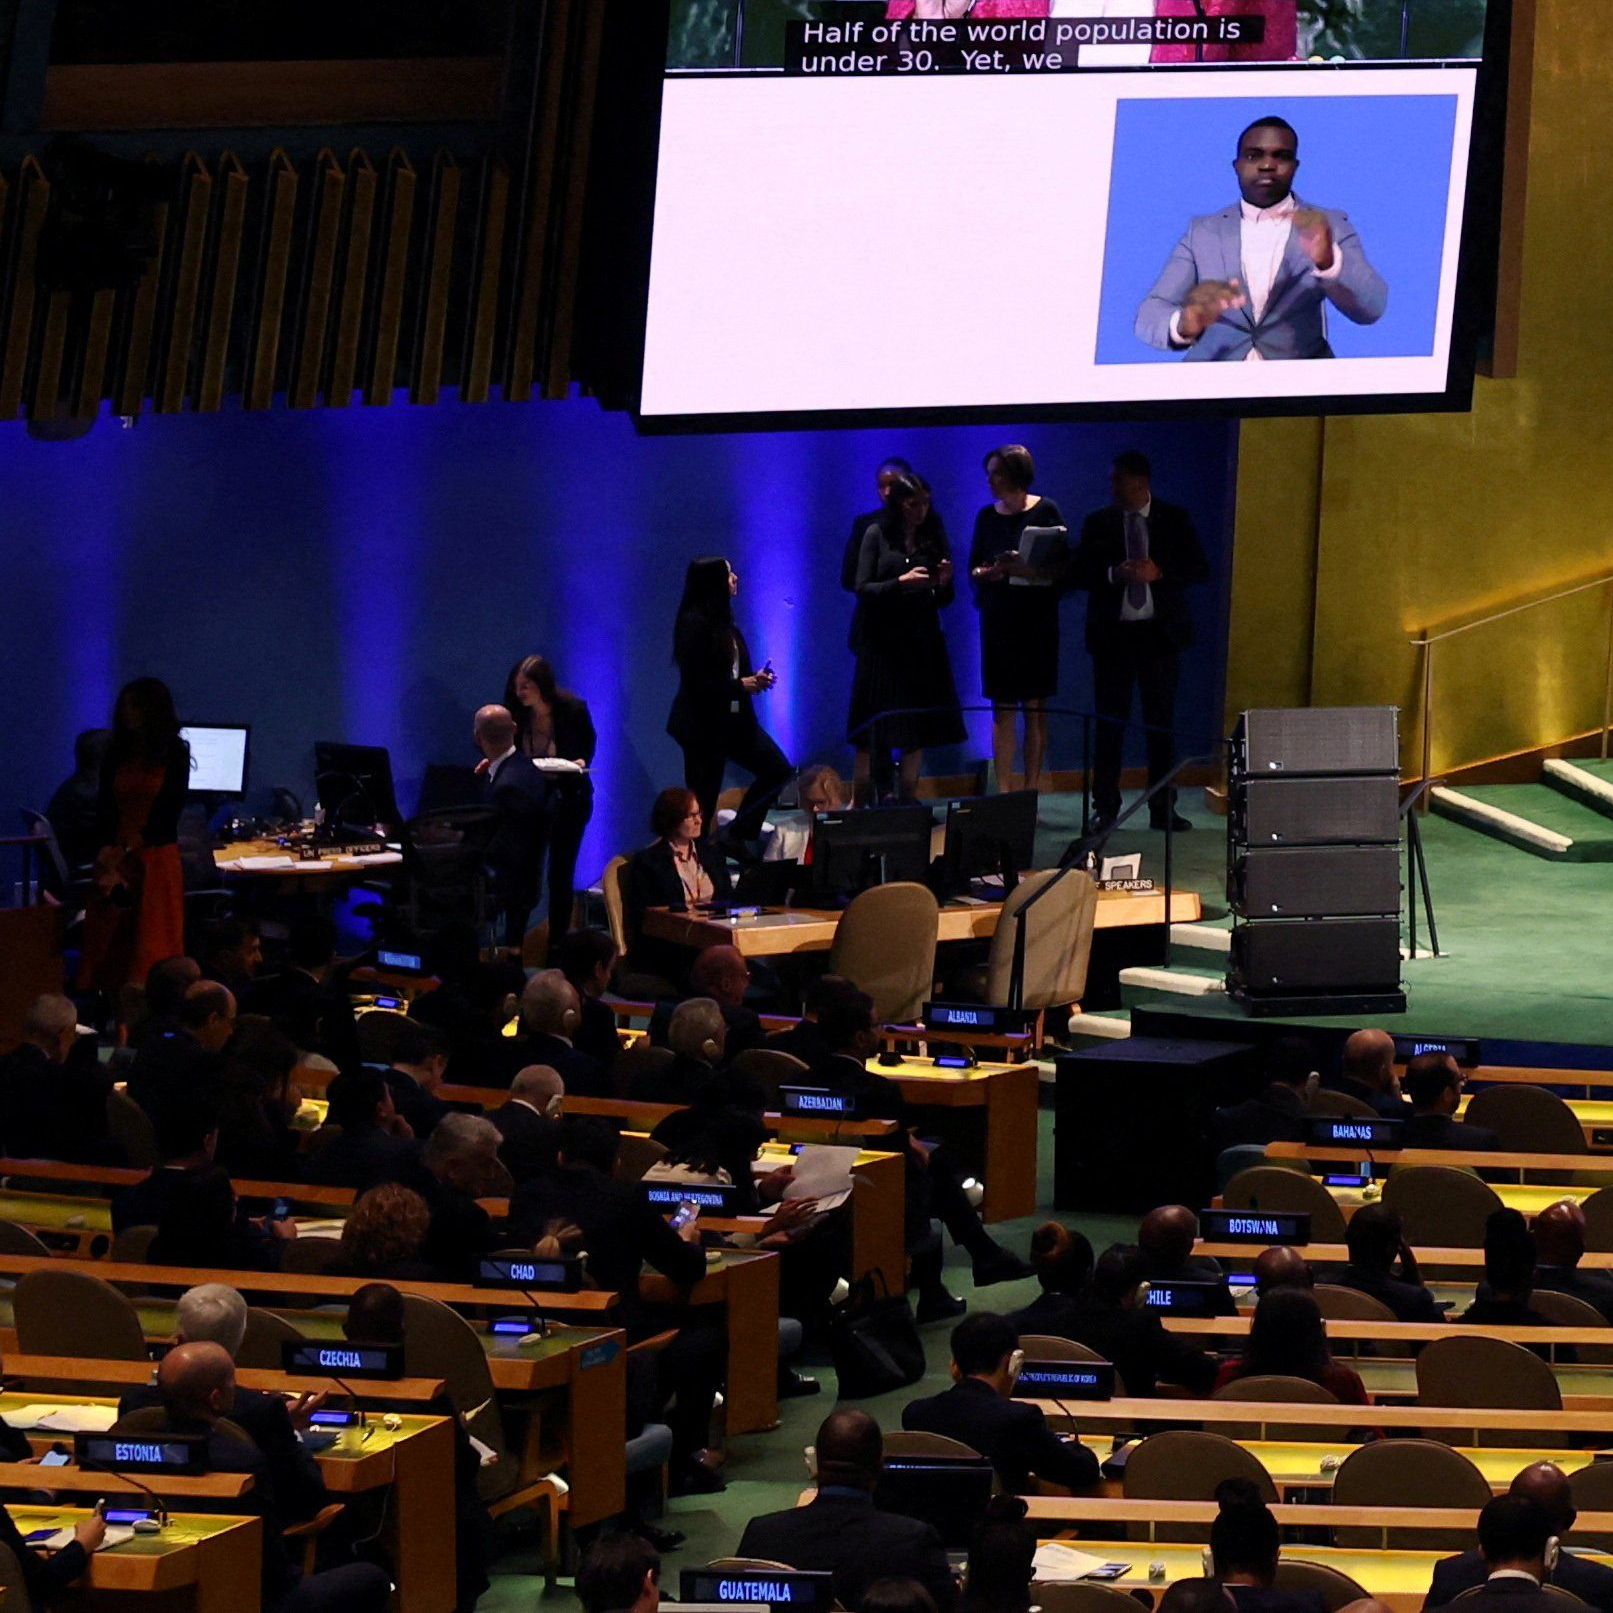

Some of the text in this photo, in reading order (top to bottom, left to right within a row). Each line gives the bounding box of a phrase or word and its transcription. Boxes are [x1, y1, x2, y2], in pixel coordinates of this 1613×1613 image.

[803, 18, 1241, 45] Half of the world population is
[801, 50, 1062, 73] under 30. Yet, we
[1104, 880, 1153, 891] SPEAKERS
[948, 1010, 978, 1025] ALBANIA
[798, 1095, 843, 1111] AZERBAIJAN
[1228, 1218, 1279, 1235] BOTSWANA
[510, 1263, 536, 1281] CHAD
[319, 1349, 362, 1368] CZECHIA
[115, 1442, 163, 1462] ESTONIA
[719, 1580, 791, 1602] GUATEMALA
